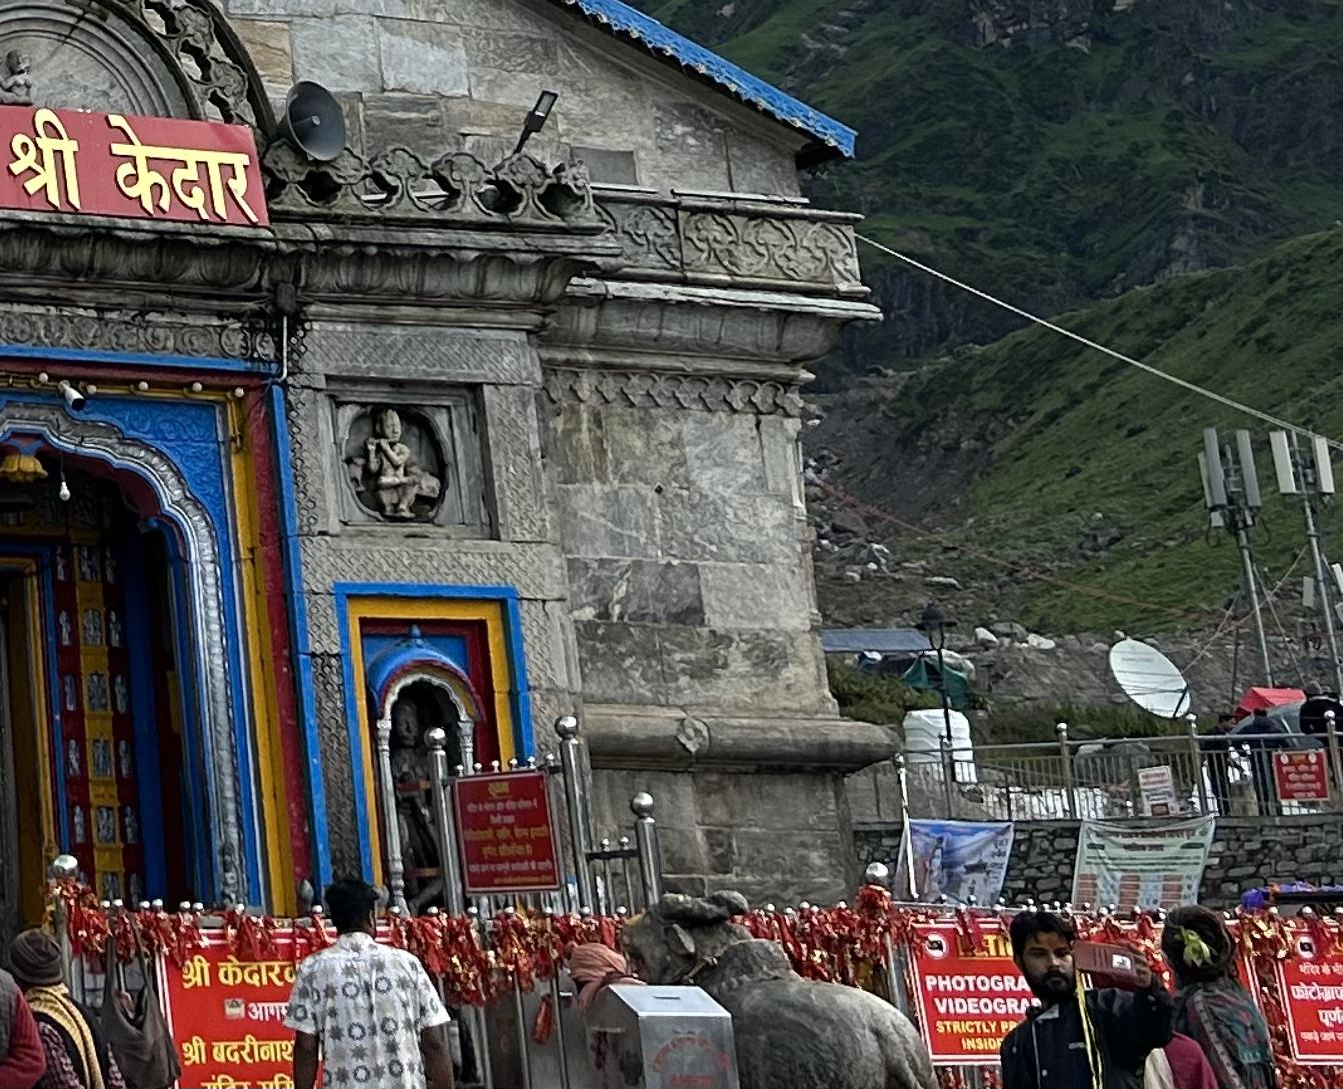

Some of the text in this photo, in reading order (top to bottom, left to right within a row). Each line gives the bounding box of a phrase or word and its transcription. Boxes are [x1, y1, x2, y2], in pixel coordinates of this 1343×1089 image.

[8, 107, 82, 211] श्री
[108, 113, 260, 225] केदार
[181, 954, 211, 989] श्री
[924, 974, 1032, 992] PHOTOGRA
[935, 1019, 998, 1034] STRICTLY
[181, 1035, 207, 1066] श्री
